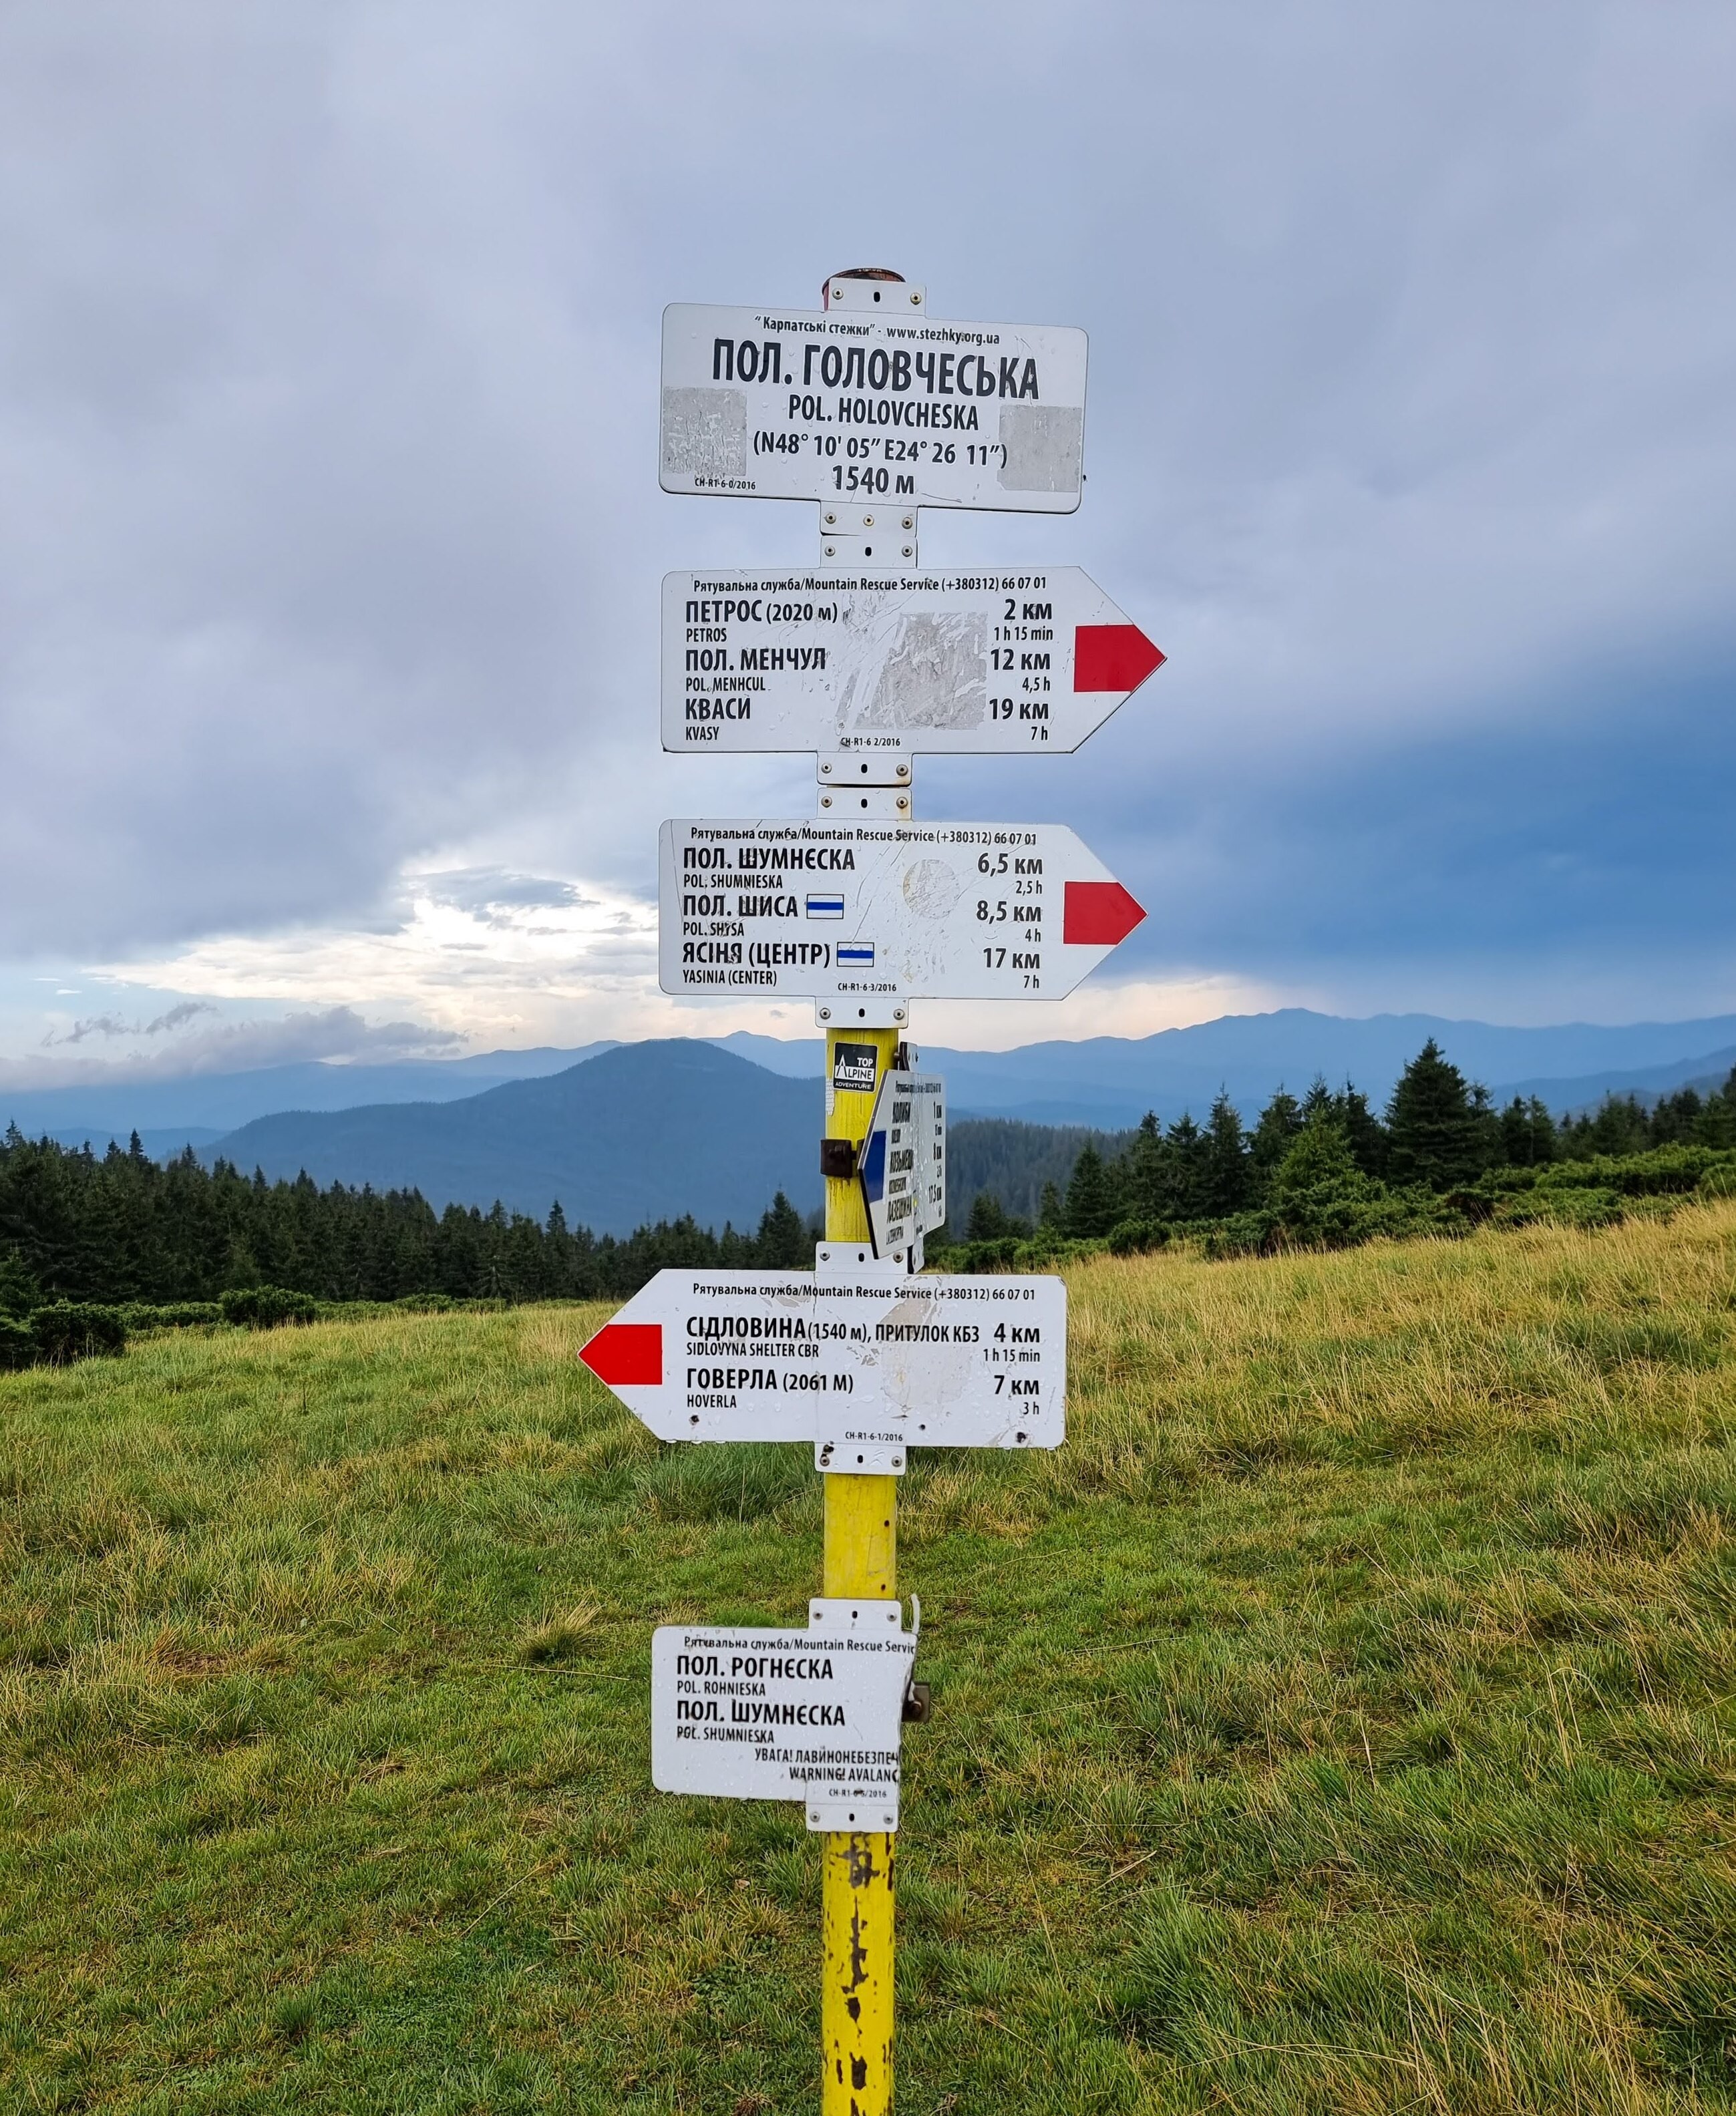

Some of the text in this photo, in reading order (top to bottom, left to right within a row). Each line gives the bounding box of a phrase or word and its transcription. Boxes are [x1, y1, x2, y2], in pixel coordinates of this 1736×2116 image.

[887, 327, 999, 346] www.stezhky.org.ua
[713, 339, 1039, 399] ПОЛ. ГОЛОВЧЕСЬКА
[789, 394, 979, 431] POL. HOLOVCHESKA
[754, 431, 808, 456] (N48°
[884, 439, 928, 462] E24°
[932, 442, 956, 464] 26
[695, 479, 756, 490] CH-R1-6-0/2016
[832, 465, 914, 494] 1540 м
[693, 577, 1047, 594] Рятувальна служба/Mountain Rescue Service (+380312) 66 07 01
[686, 600, 838, 624] ПЕТРОС (2020 м)
[1004, 598, 1052, 621] 2 км
[686, 628, 727, 643] PETROS
[994, 626, 1053, 641] 1 h 15 min
[686, 648, 826, 671] ПОЛ. МЕНЧУЛ
[990, 649, 1051, 671] 12 км
[686, 677, 766, 691] POL. MENHCUL
[1022, 677, 1051, 694] 4,5 h
[685, 698, 751, 720] КВАСИ
[989, 698, 1049, 720] 19 км
[685, 726, 719, 741] KVASY
[1031, 725, 1048, 741] 7 h
[691, 827, 1036, 846] Рятувальна служба/Mountain Rescue Service (+380312) 66 07 01
[684, 848, 855, 870] ПОЛ. ШУМНЄСКА
[978, 852, 1043, 876] 6,5 км
[684, 874, 783, 889] POL. SHUMNIESKA
[1015, 880, 1043, 896] 2,5 h
[683, 895, 798, 917] ПОЛ. ШИСА
[977, 900, 1041, 924] 8,5 км
[683, 922, 745, 936] POL. SHYSA
[1025, 928, 1041, 942] 4 h
[683, 942, 831, 968] ЯСІНЯ (ЦЕНТР)
[983, 948, 1040, 968] 17 км
[683, 969, 777, 987] YASINIA (CENTER)
[1023, 975, 1039, 989] 7 h
[838, 983, 896, 991] CH-R1-6-3/2016
[836, 1054, 872, 1080] ALPINE
[857, 1057, 874, 1067] TOP
[835, 1081, 871, 1089] ADVENTURE
[693, 1283, 1035, 1300] Рятувальна служба/Mountain Rescue Service (+380312) 66 07 01
[876, 1324, 949, 1342] ПРИТУЛОК
[953, 1326, 979, 1343] КБЗ
[993, 1323, 1040, 1343] 4 км
[687, 1342, 819, 1357] SIDLOVYNA SHELTER CBR
[983, 1348, 1040, 1362] 1 h 15 min
[687, 1368, 777, 1390] ГОВЕРЛА
[783, 1373, 827, 1393] (2061
[994, 1375, 1039, 1395] 7 км
[687, 1394, 737, 1409] HOVERLA
[1023, 1401, 1039, 1415] 3 h
[845, 1431, 902, 1441] CH-R1-6-1/2016
[751, 1638, 844, 1651] служба/Mountain
[847, 1640, 882, 1651] Rescue
[677, 1655, 833, 1679] ПОЛ. РОГНЄСКА
[677, 1681, 766, 1697] POL. ROHNIESKA
[677, 1701, 845, 1726] ПОЛ. ШУМНЄСКА
[703, 1727, 774, 1743] SHUMNIESKA
[755, 1748, 793, 1762] УВАГА!
[790, 1767, 845, 1781] WARNING!
